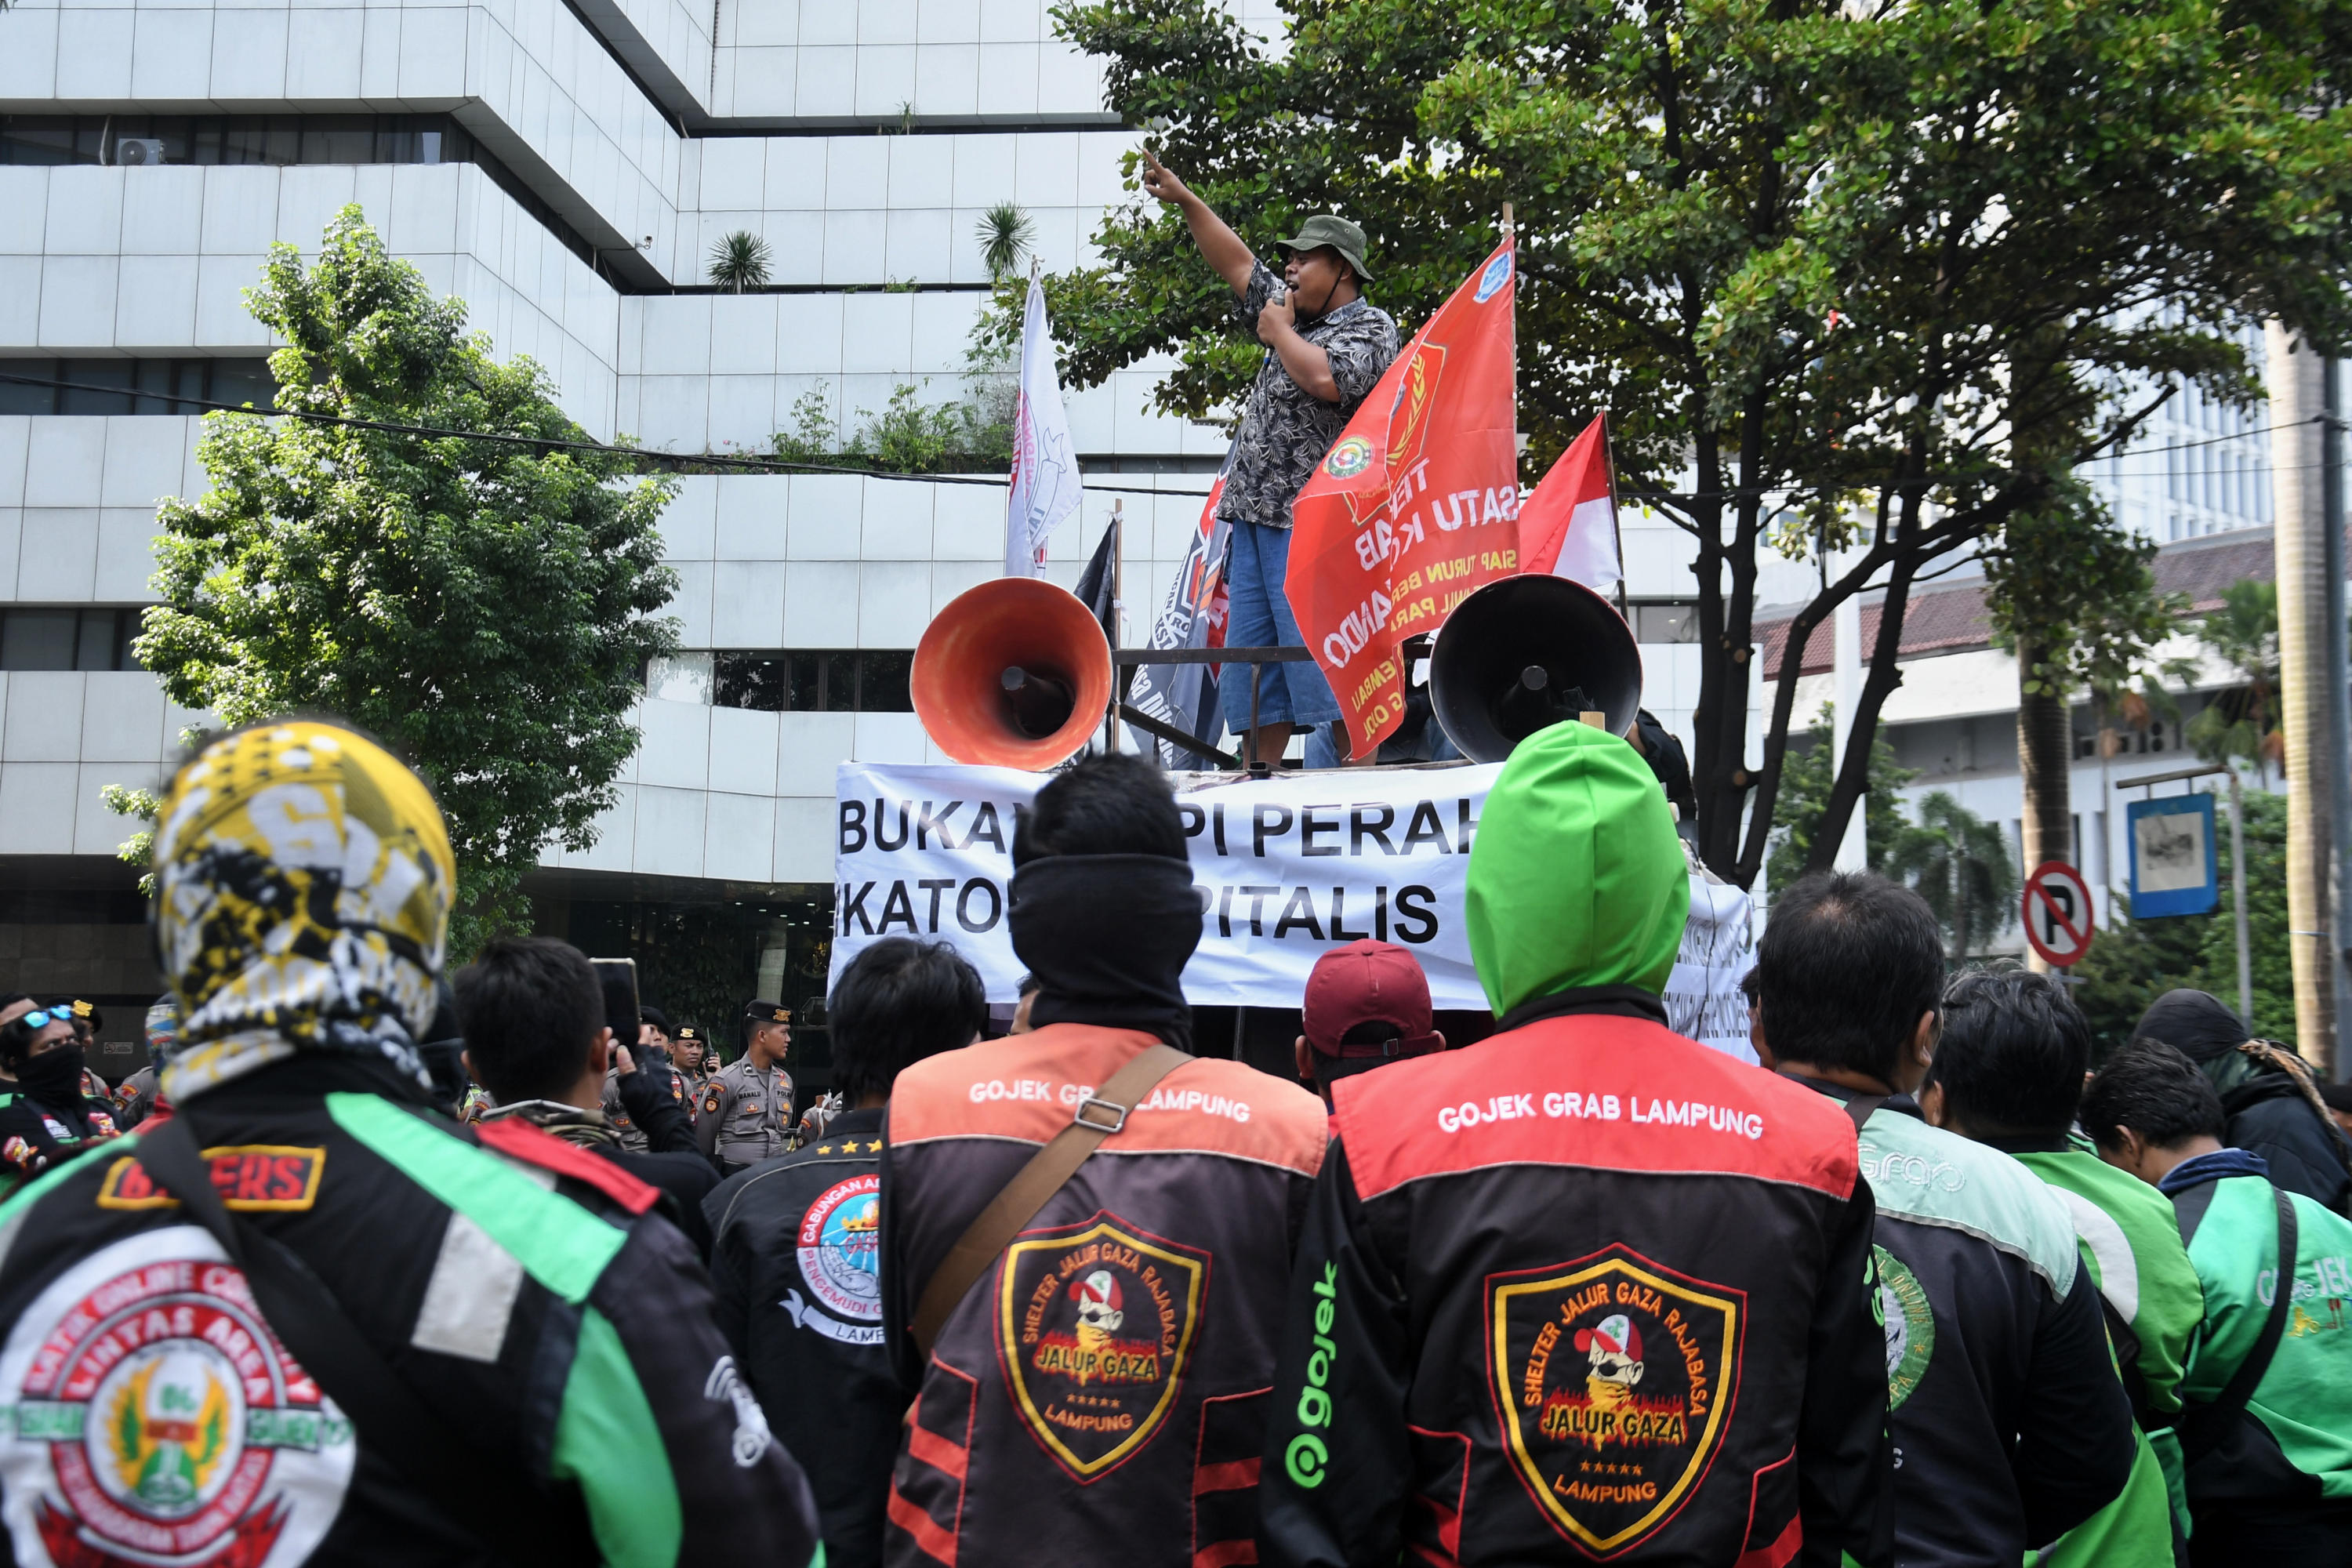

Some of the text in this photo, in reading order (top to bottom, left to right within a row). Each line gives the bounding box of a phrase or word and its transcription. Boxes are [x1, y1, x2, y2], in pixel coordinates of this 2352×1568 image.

[840, 798, 1021, 855] BUKA
[2043, 885, 2074, 944] P
[969, 1080, 1052, 1104] GOJEK
[1059, 1083, 1094, 1107] GR
[1439, 1091, 1763, 1140] GOJEK GRAB LAMPUNG
[802, 1179, 862, 1243] GABUNGAN
[803, 1249, 867, 1314] PENGEMUDI
[1022, 1242, 1177, 1357] SHELTER JALUR GAZA RAJABASA
[1893, 1274, 1929, 1325] ONLINE
[66, 1305, 195, 1397] LINTAS
[203, 1315, 271, 1405] AREA
[1038, 1345, 1157, 1378] JALUR GAZA
[1298, 1259, 1338, 1429] gojek
[1524, 1281, 1708, 1417] SHELTER JALUR GAZA RAJABASA
[1044, 1403, 1134, 1432] LAMPUNG
[1543, 1406, 1684, 1439] JALUR GAZA
[1553, 1473, 1658, 1503] LAMPUNG
